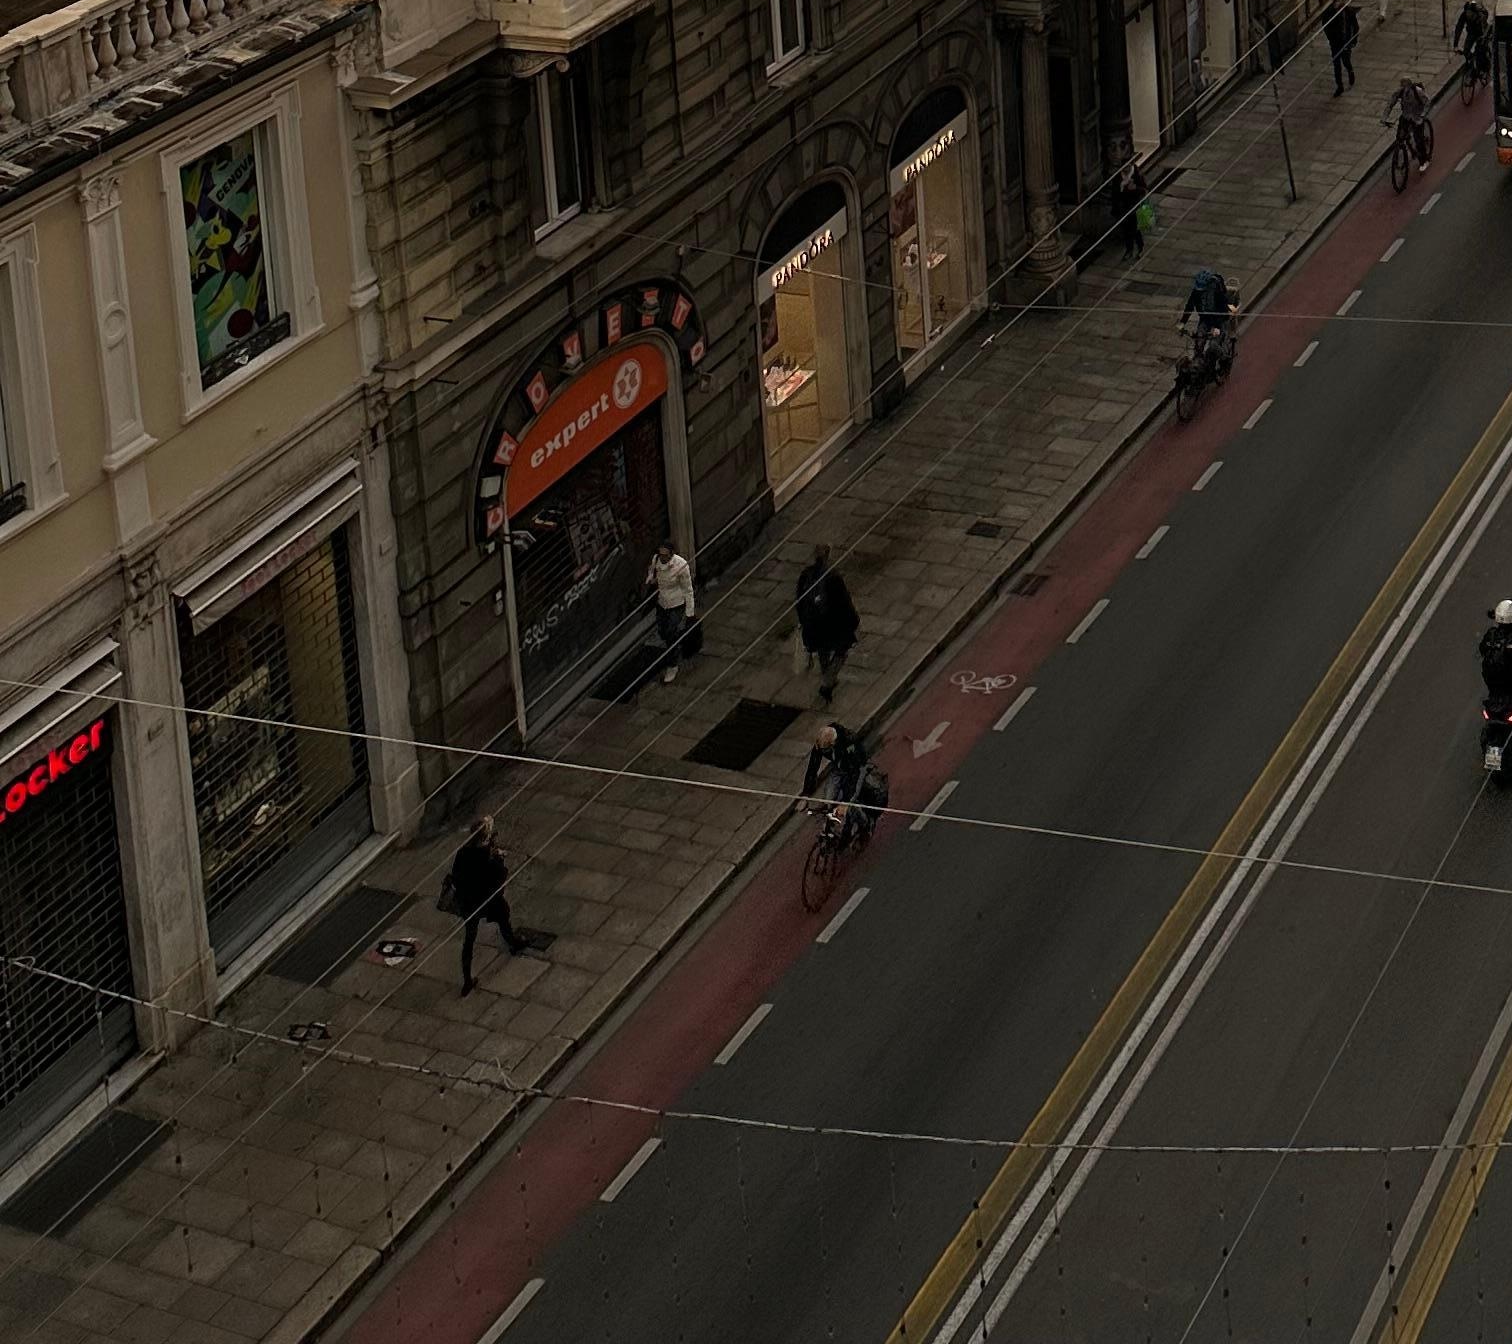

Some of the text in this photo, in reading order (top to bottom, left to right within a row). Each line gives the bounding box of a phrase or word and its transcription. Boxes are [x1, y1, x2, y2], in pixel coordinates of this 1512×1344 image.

[905, 130, 958, 184] PANDORA
[774, 230, 835, 289] PANDORA
[530, 392, 610, 469] expert
[0, 718, 105, 824] ocker
